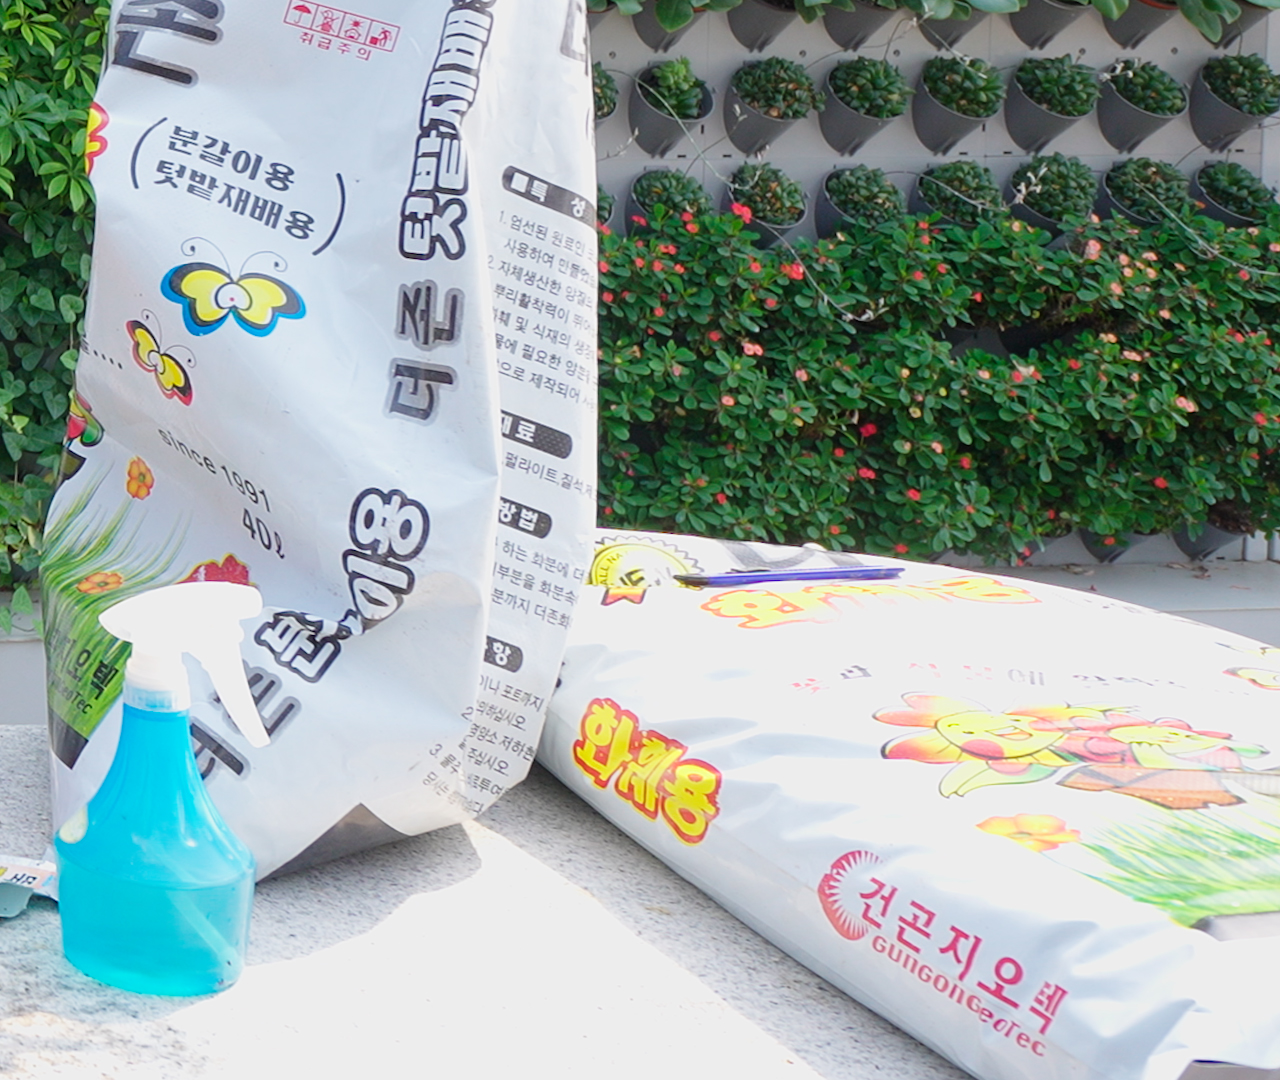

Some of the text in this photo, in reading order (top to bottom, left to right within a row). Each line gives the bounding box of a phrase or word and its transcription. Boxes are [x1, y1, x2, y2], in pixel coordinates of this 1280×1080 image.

[299, 31, 372, 61] 취급주의
[167, 124, 296, 192] 분갈이용
[153, 158, 316, 240] 텃밭재배용
[510, 214, 549, 241] 엄선된
[503, 238, 555, 269] 사용하여
[383, 278, 466, 426] 더존
[521, 343, 562, 371] 필요한
[158, 428, 272, 514] since 1991
[573, 701, 722, 844] 화훼용
[858, 877, 1069, 1036] 건곤지오텍
